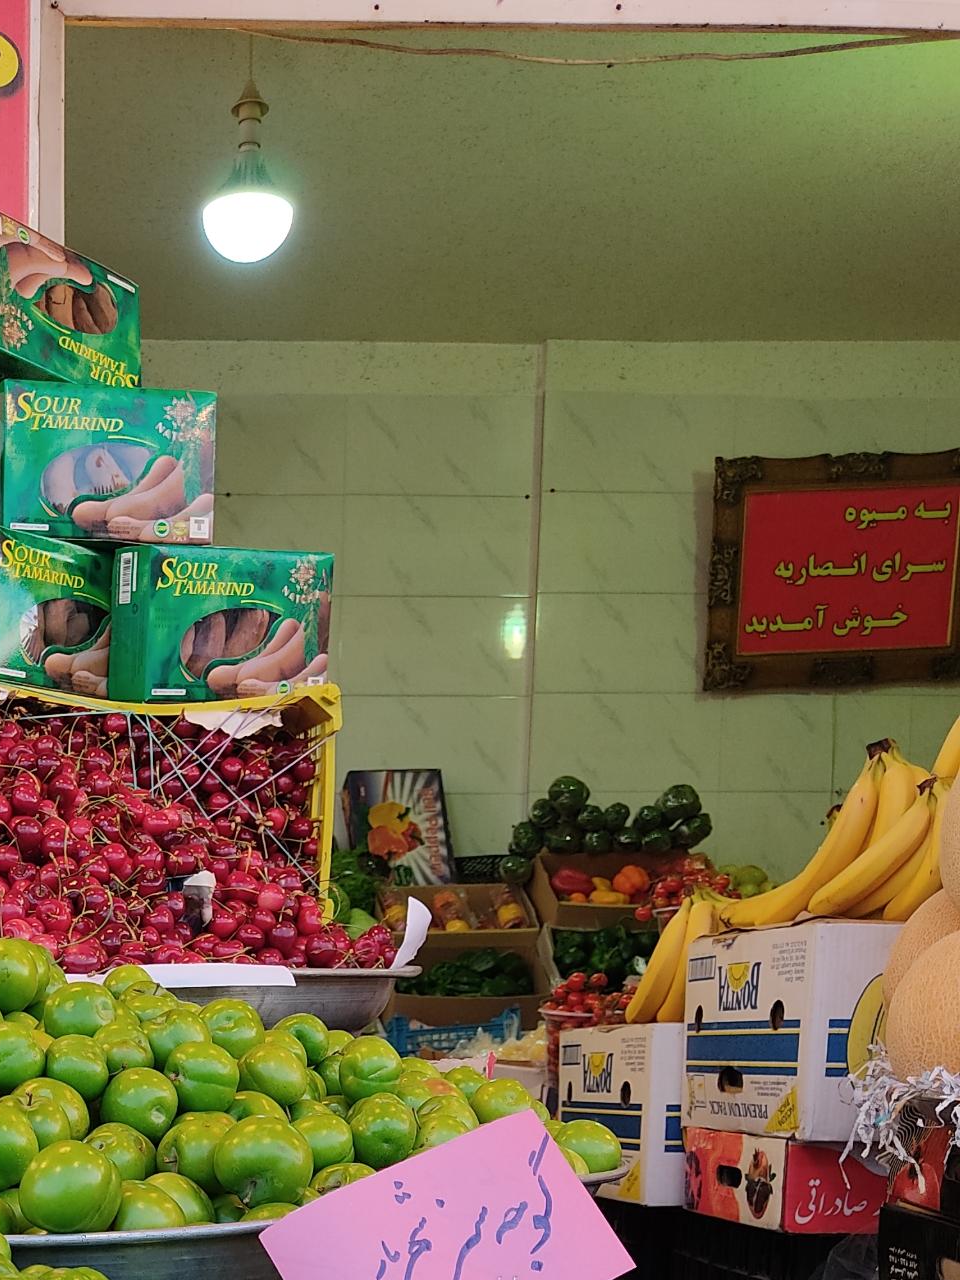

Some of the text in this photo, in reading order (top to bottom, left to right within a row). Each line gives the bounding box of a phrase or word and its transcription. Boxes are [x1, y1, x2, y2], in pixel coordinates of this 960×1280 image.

[58, 335, 128, 374] TAMARIND
[89, 364, 139, 389] SOUR
[13, 391, 82, 424] SOUR
[30, 412, 125, 434] TAMARIND
[844, 501, 952, 530] به میوه
[12, 562, 86, 590] TAMARIND
[156, 556, 219, 591] SOUR
[774, 551, 948, 586] سرای انصاریه
[172, 577, 256, 599] TAMARIND
[744, 603, 910, 639] خوش آمدید
[718, 961, 762, 1012] BONITA
[582, 1052, 614, 1094] BONITA
[708, 1100, 769, 1120] PREMIUM PACK
[495, 1131, 554, 1273] گوجه
[794, 1178, 868, 1225] صادراتی
